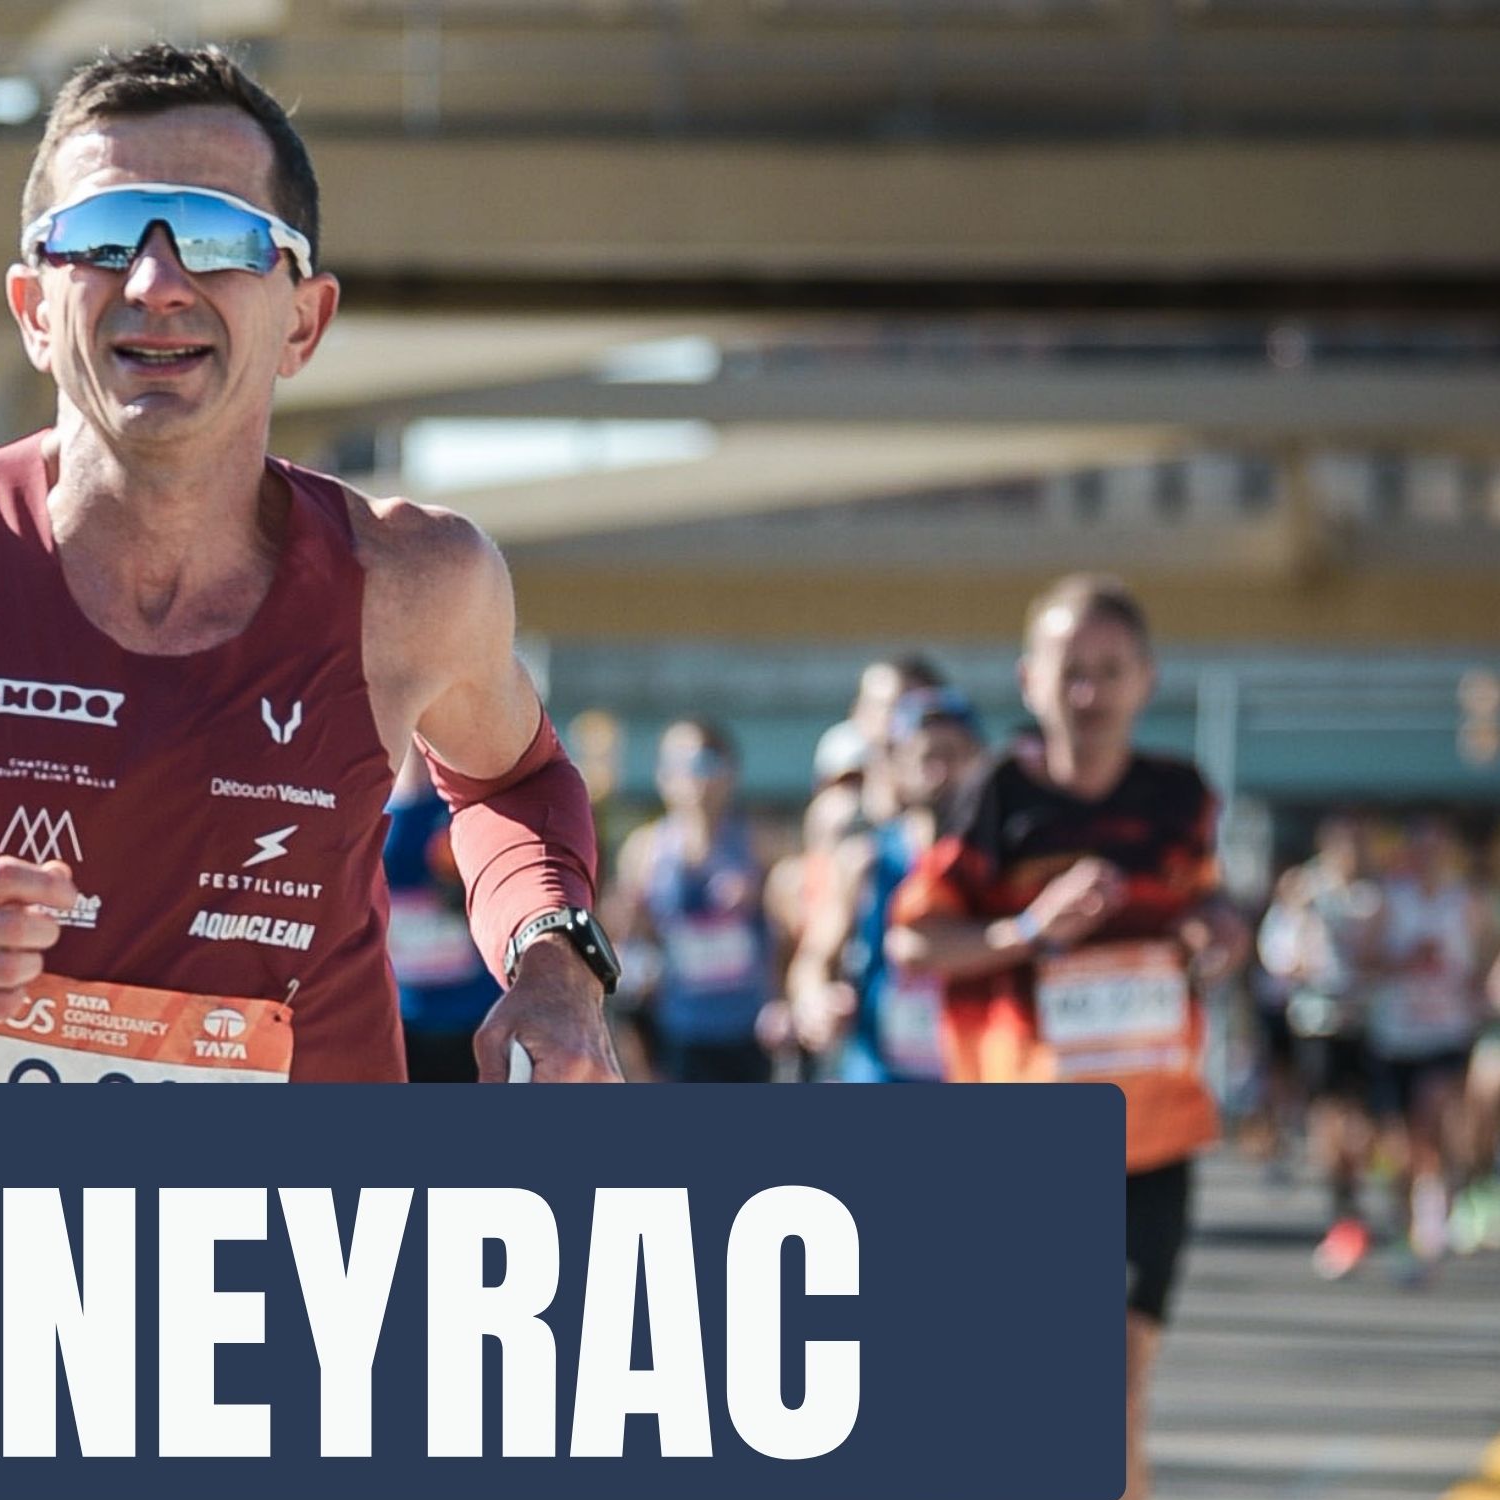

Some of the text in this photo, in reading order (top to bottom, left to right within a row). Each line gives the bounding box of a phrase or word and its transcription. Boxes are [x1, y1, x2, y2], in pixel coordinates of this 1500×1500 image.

[198, 872, 323, 899] FESTILIGHT
[188, 909, 316, 951] AQUACLEAN
[65, 993, 111, 1012] TATA
[61, 1024, 128, 1047] SERVICES
[63, 1009, 170, 1037] CONSULTANCY
[193, 1039, 248, 1060] TATA
